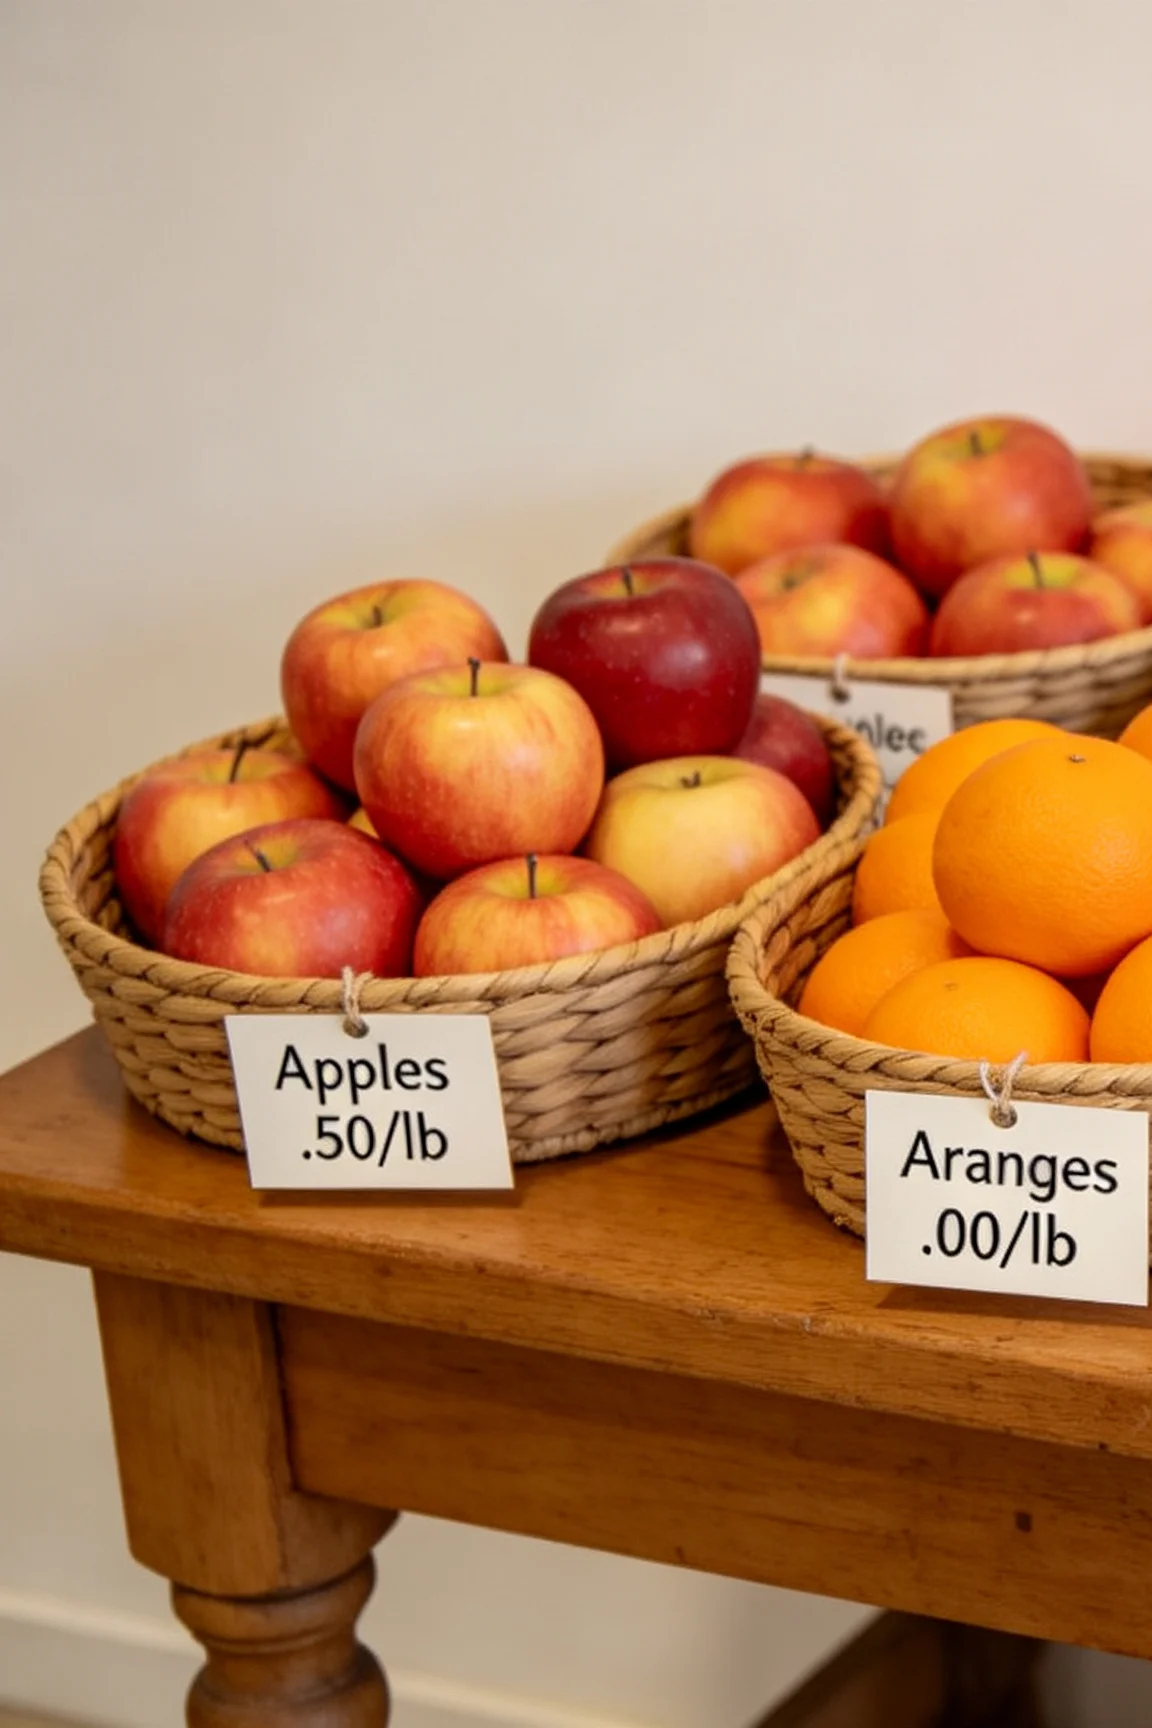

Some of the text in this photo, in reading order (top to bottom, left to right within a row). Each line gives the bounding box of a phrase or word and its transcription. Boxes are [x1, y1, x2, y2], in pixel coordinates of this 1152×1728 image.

[275, 1043, 450, 1106] Apples
[302, 1110, 449, 1168] .50/lb
[900, 1130, 1118, 1203] Aranges
[922, 1208, 1077, 1269] .00/lb
